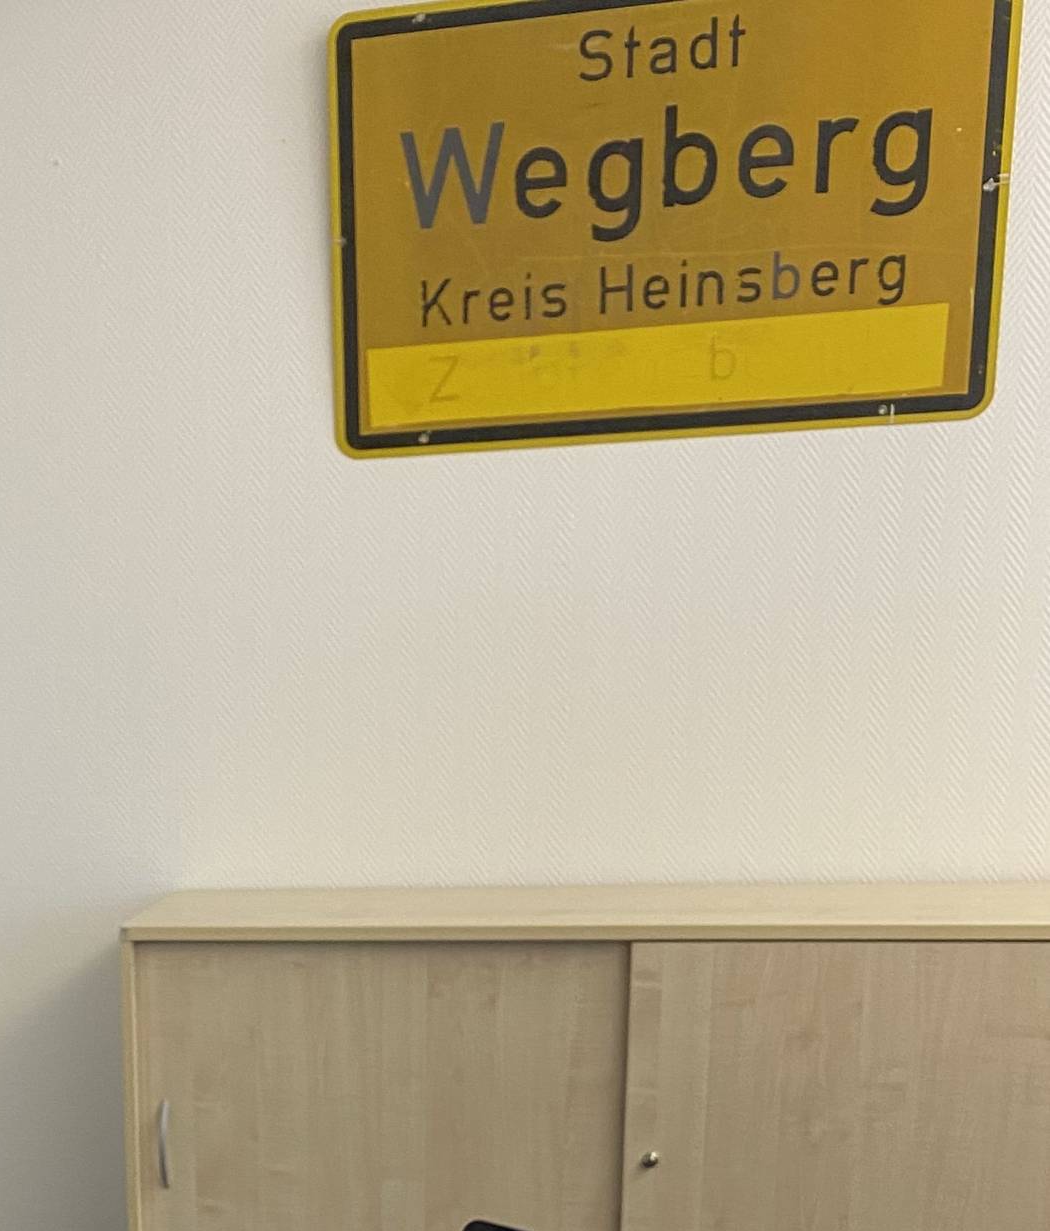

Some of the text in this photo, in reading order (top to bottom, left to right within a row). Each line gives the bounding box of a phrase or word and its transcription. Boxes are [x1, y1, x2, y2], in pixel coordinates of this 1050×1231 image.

[579, 15, 748, 82] Stadt
[400, 105, 934, 243] Wegberg
[420, 251, 907, 328] Kreis Heinsberg
